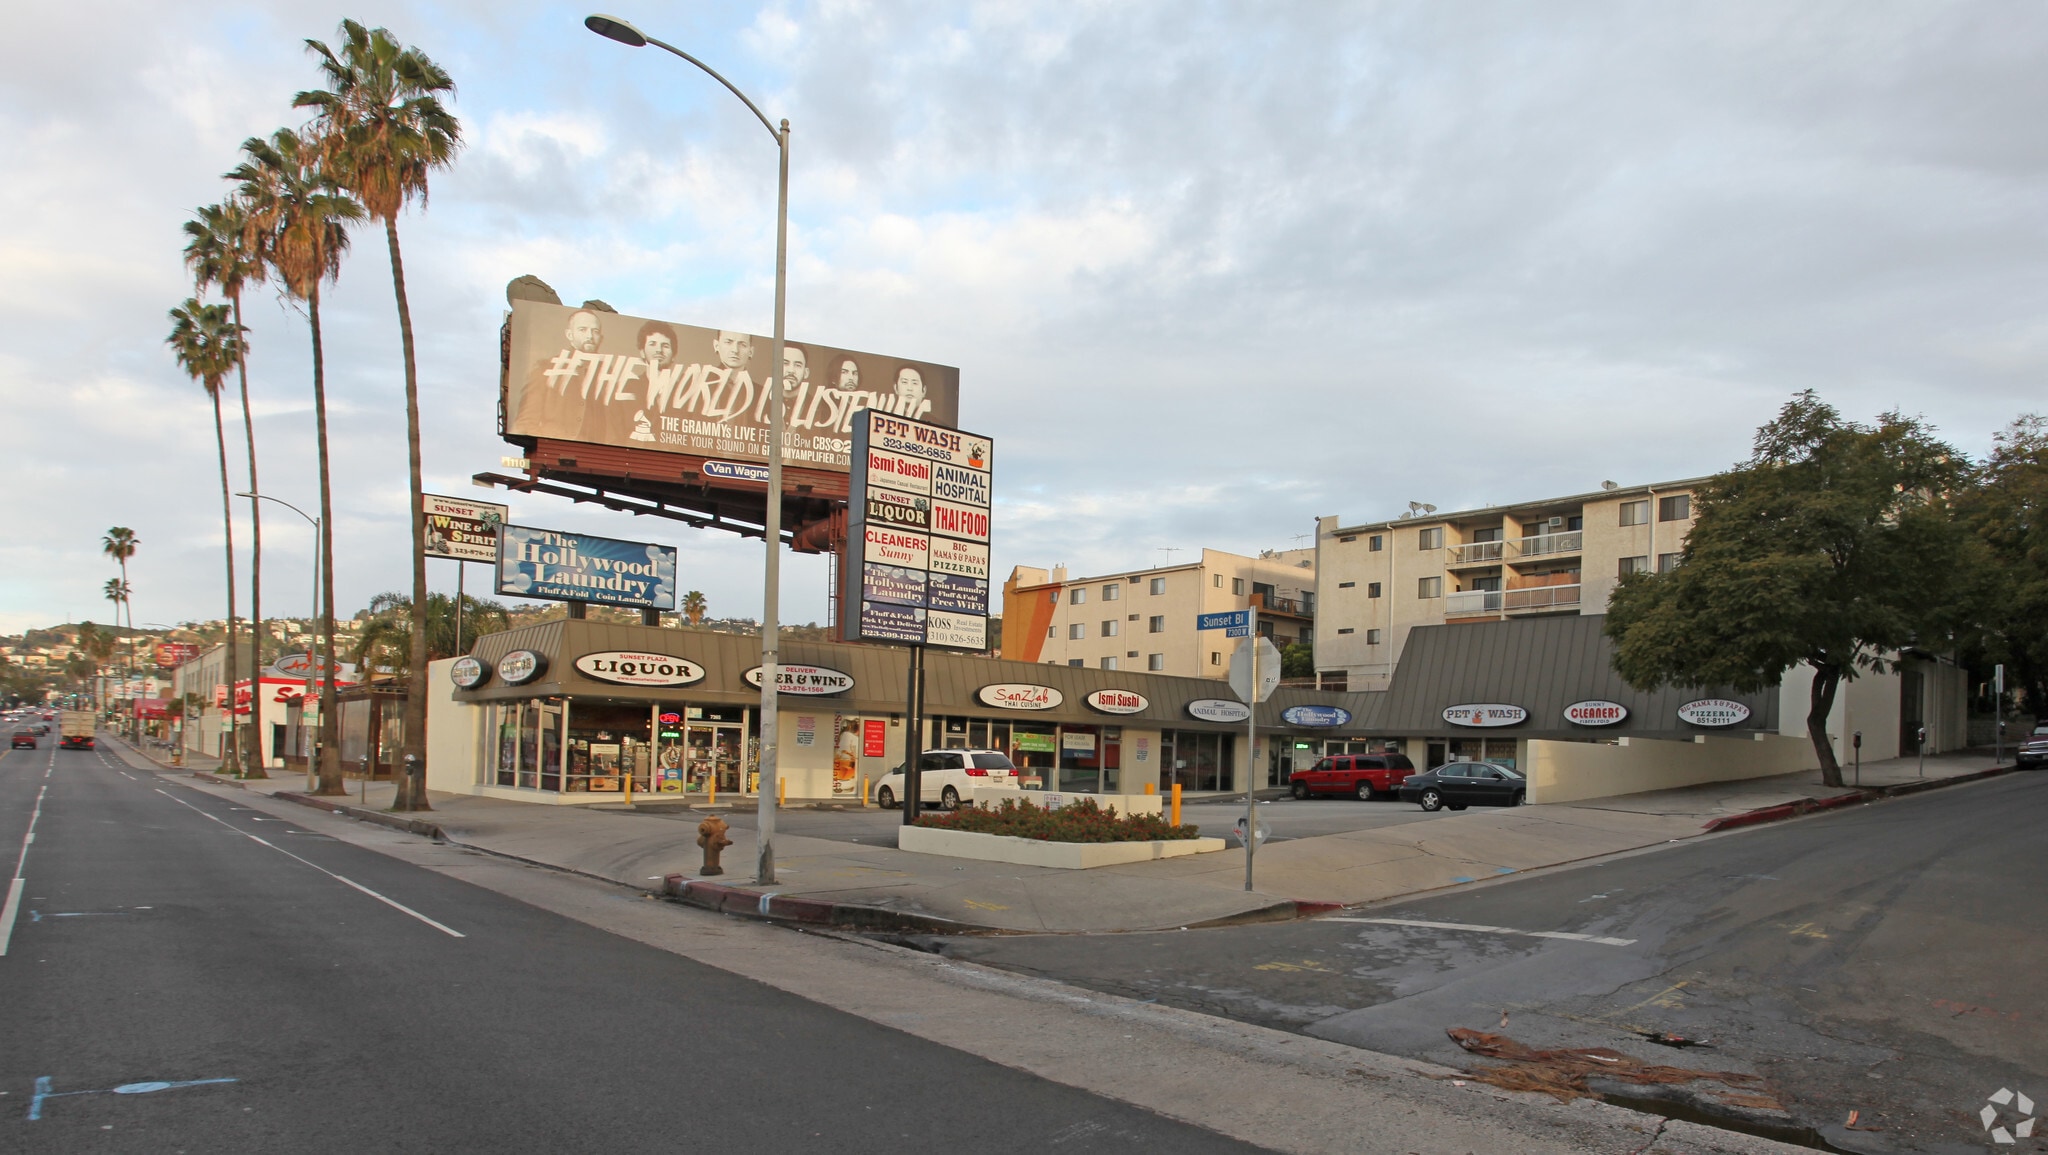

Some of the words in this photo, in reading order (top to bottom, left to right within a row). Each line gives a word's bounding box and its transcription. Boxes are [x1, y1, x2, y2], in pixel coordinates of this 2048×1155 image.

[544, 349, 648, 406] #THE
[645, 360, 754, 423] WORLD
[660, 416, 679, 432] THE
[734, 426, 756, 441] LIVE
[758, 430, 770, 443] FE
[874, 416, 910, 438] PET
[914, 426, 962, 452] WASH
[660, 432, 688, 446] SHARE
[690, 436, 713, 449] YOUR
[716, 440, 745, 454] SOUND
[748, 444, 760, 455] ON
[883, 437, 952, 461] 323-882-6855
[710, 464, 732, 474] Van
[734, 466, 769, 479] Wagne
[870, 452, 895, 473] Ismi
[897, 458, 929, 480] Sushi
[936, 466, 987, 489] ANIMAL
[880, 492, 911, 505] SUNSET
[935, 482, 987, 504] HOSPITAL
[434, 504, 474, 516] SUNSET
[869, 502, 926, 524] LIQUOR
[434, 515, 472, 532] WINE
[935, 506, 959, 531] THAI
[961, 510, 987, 537] FOOD
[540, 532, 578, 548] The
[865, 530, 927, 551] CLEANERS
[952, 542, 968, 552] BIG
[516, 542, 658, 578] Hollywood
[879, 546, 914, 563] Sunny
[933, 549, 958, 560] MAMA'S
[964, 555, 986, 566] PAPA'S
[870, 568, 888, 578] The
[934, 560, 984, 576] PIZZERIA
[533, 562, 650, 598] Laundry
[864, 575, 925, 592] Hollywood
[538, 586, 560, 597] Fluff
[570, 589, 589, 598] Fold
[596, 592, 616, 602] Coin
[618, 594, 654, 606] Laundry
[872, 586, 924, 604] Laundry
[930, 581, 950, 590] Coin
[952, 584, 987, 596] Laundry
[931, 597, 954, 608] Free
[956, 600, 984, 611] WiFi!
[862, 616, 876, 624] Pick
[878, 618, 888, 626] Up
[896, 620, 923, 630] Delivery
[928, 616, 952, 629] KOSS
[956, 618, 968, 626] Real
[968, 620, 983, 628] Estate
[1204, 614, 1232, 627] Sunset
[1236, 614, 1244, 624] Bl
[928, 631, 948, 642] (310)
[950, 634, 984, 645] 826-5635
[1228, 628, 1242, 636] 7300
[1242, 628, 1246, 636] W
[593, 660, 692, 677] LIQUOR
[756, 672, 794, 684] BER
[796, 674, 806, 684] &
[810, 676, 846, 686] WINE
[1004, 700, 1018, 708] THAI
[1098, 692, 1116, 706] Ismi
[1118, 694, 1140, 708] Sushi
[1193, 708, 1216, 716] ANIMAL
[1221, 710, 1247, 718] HOSPITAL
[1446, 710, 1470, 718] PET
[1488, 710, 1522, 718] WASH
[1570, 707, 1620, 719] CLEANERS
[1680, 704, 1691, 714] BIG
[660, 714, 680, 722] OPEN
